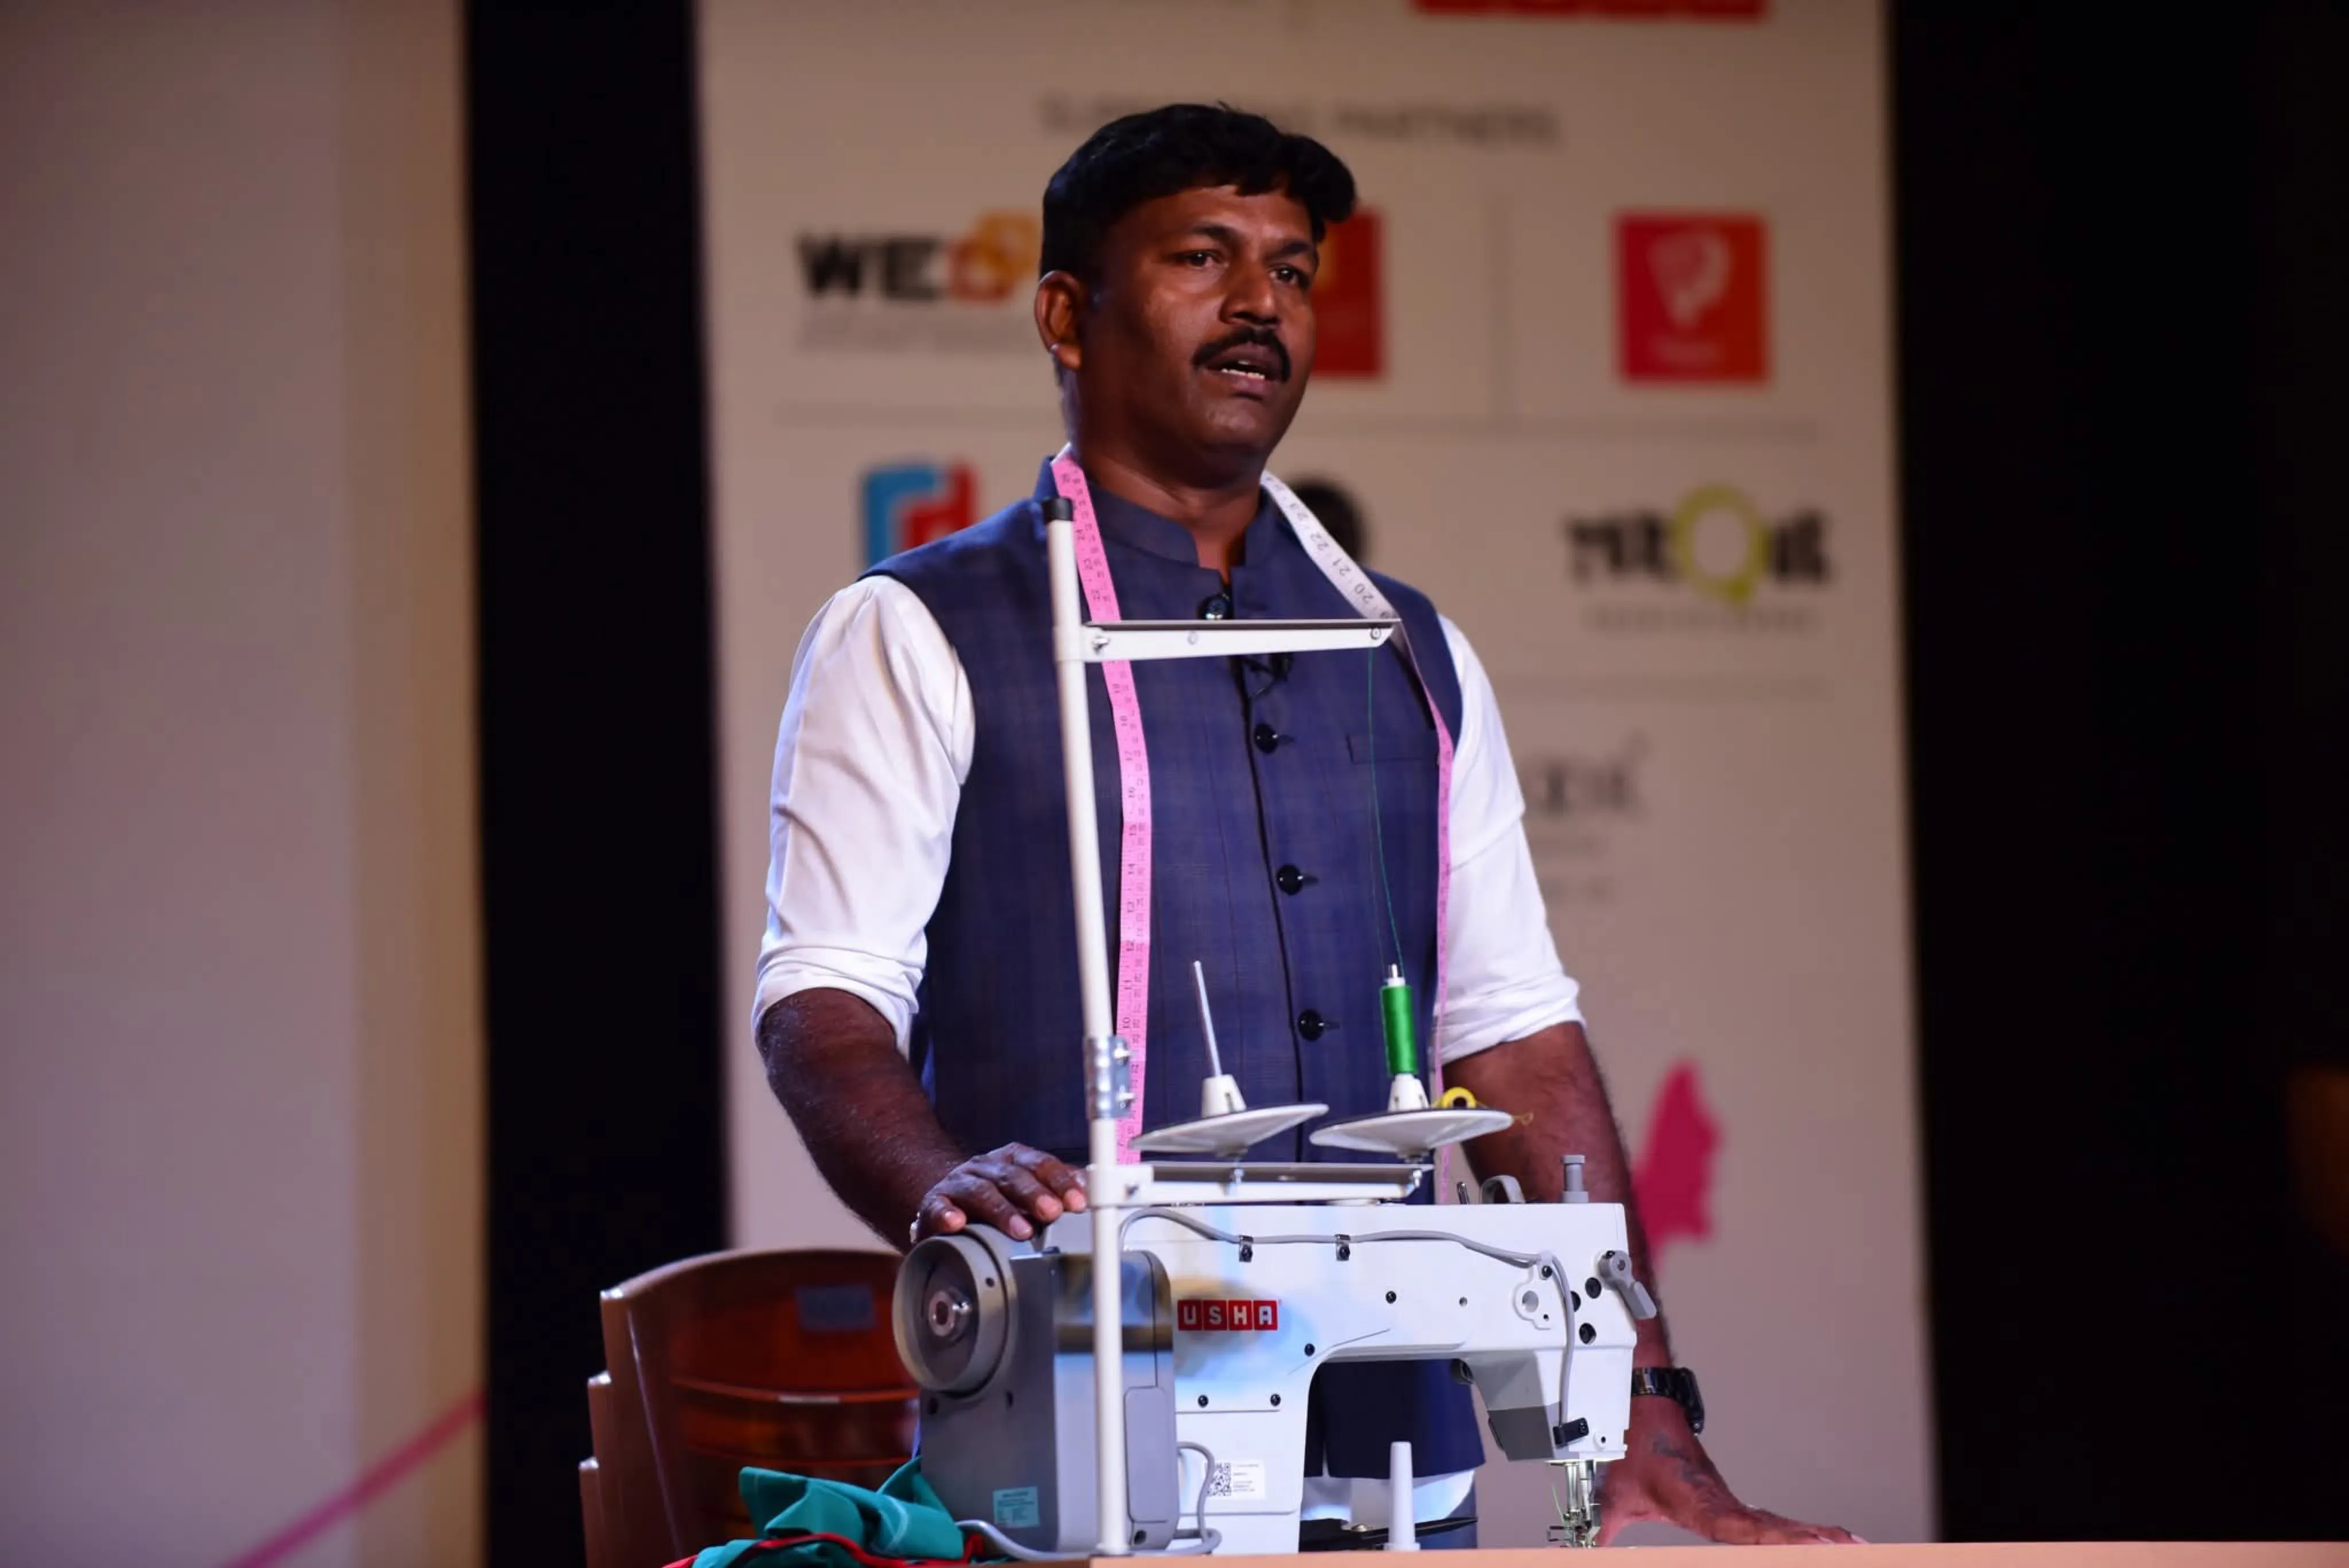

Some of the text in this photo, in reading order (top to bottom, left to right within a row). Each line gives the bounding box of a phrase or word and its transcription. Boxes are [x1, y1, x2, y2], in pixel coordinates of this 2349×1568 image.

[1310, 532, 1328, 551] 22
[1332, 557, 1351, 576] 21
[1354, 583, 1374, 604] 20
[1183, 1305, 1273, 1325] USHA
